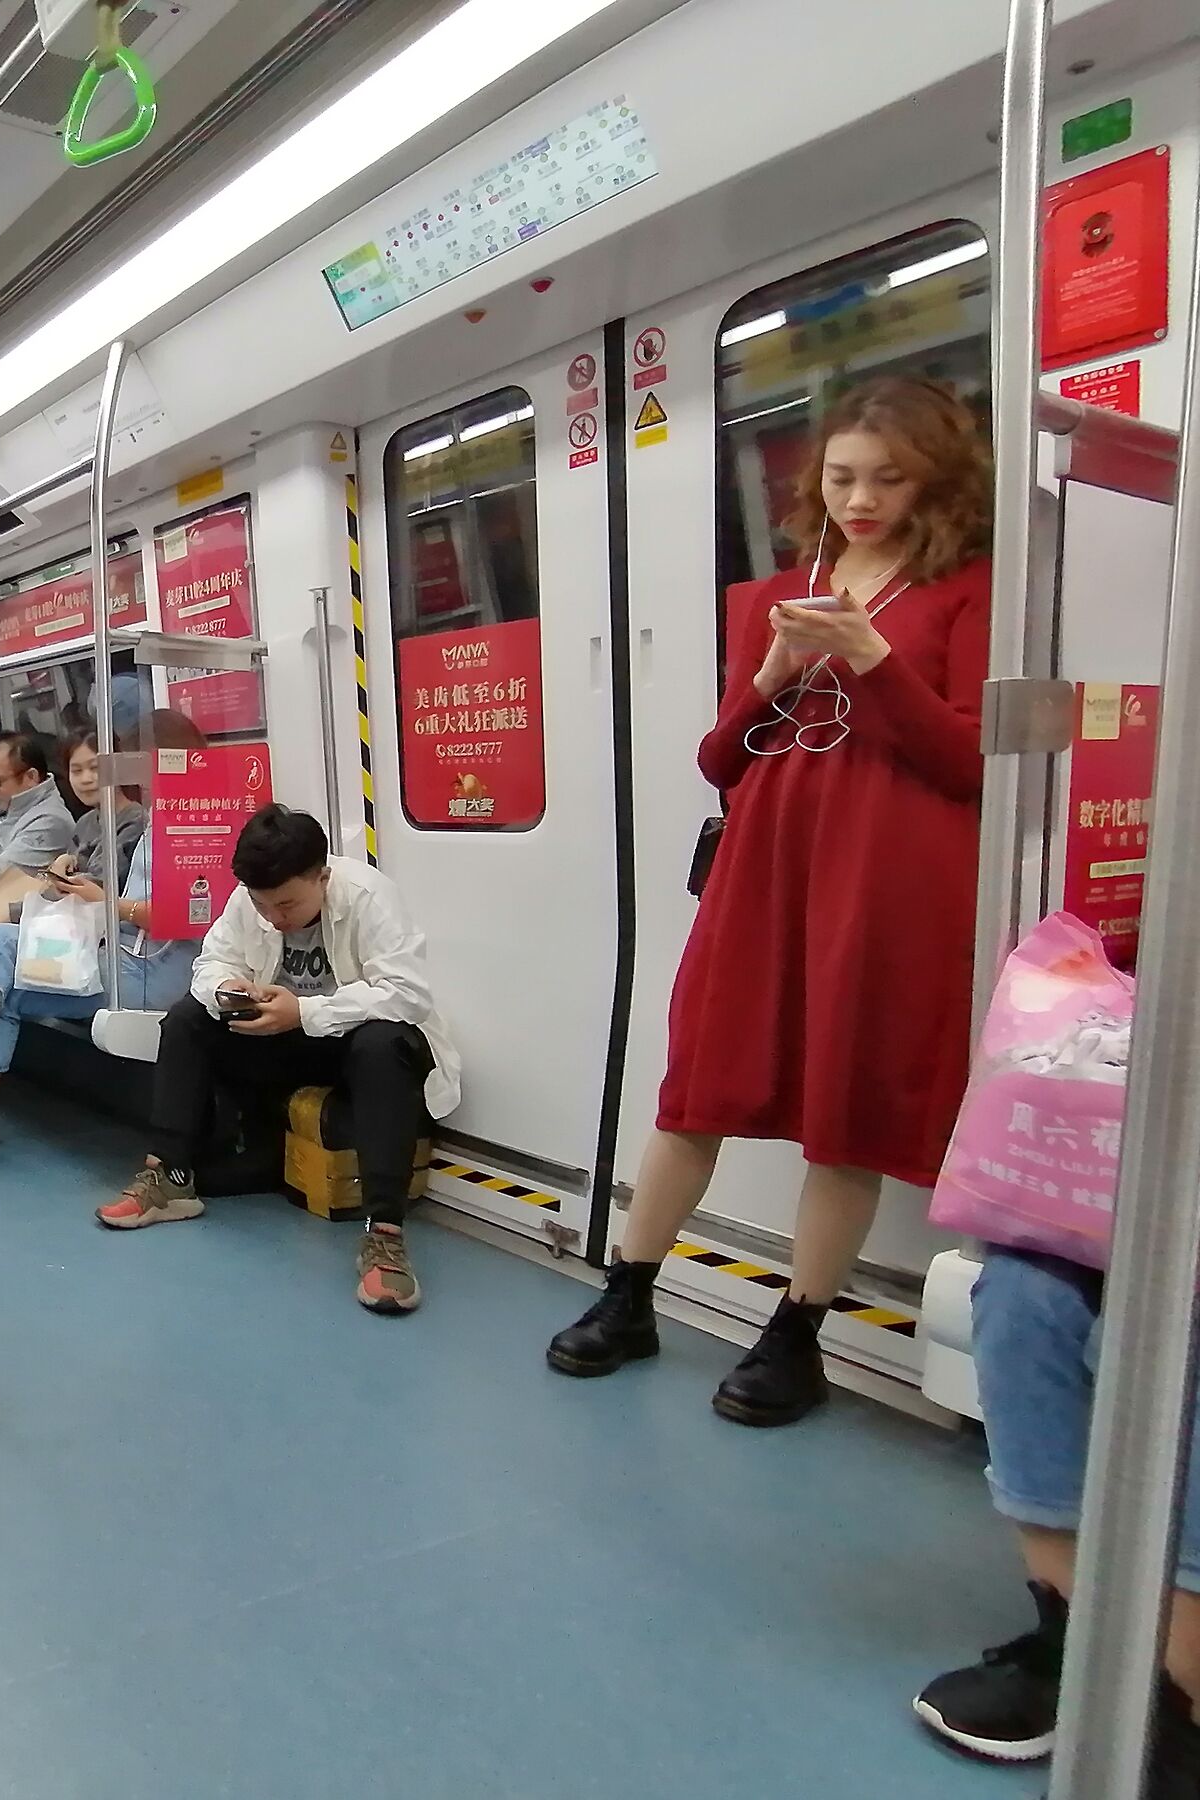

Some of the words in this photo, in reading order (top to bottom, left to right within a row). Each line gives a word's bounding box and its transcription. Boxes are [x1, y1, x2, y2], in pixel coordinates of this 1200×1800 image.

[441, 641, 490, 662] MAIYA
[414, 705, 529, 735] 6重大礼狂派送
[1079, 797, 1145, 829] 数字化精
